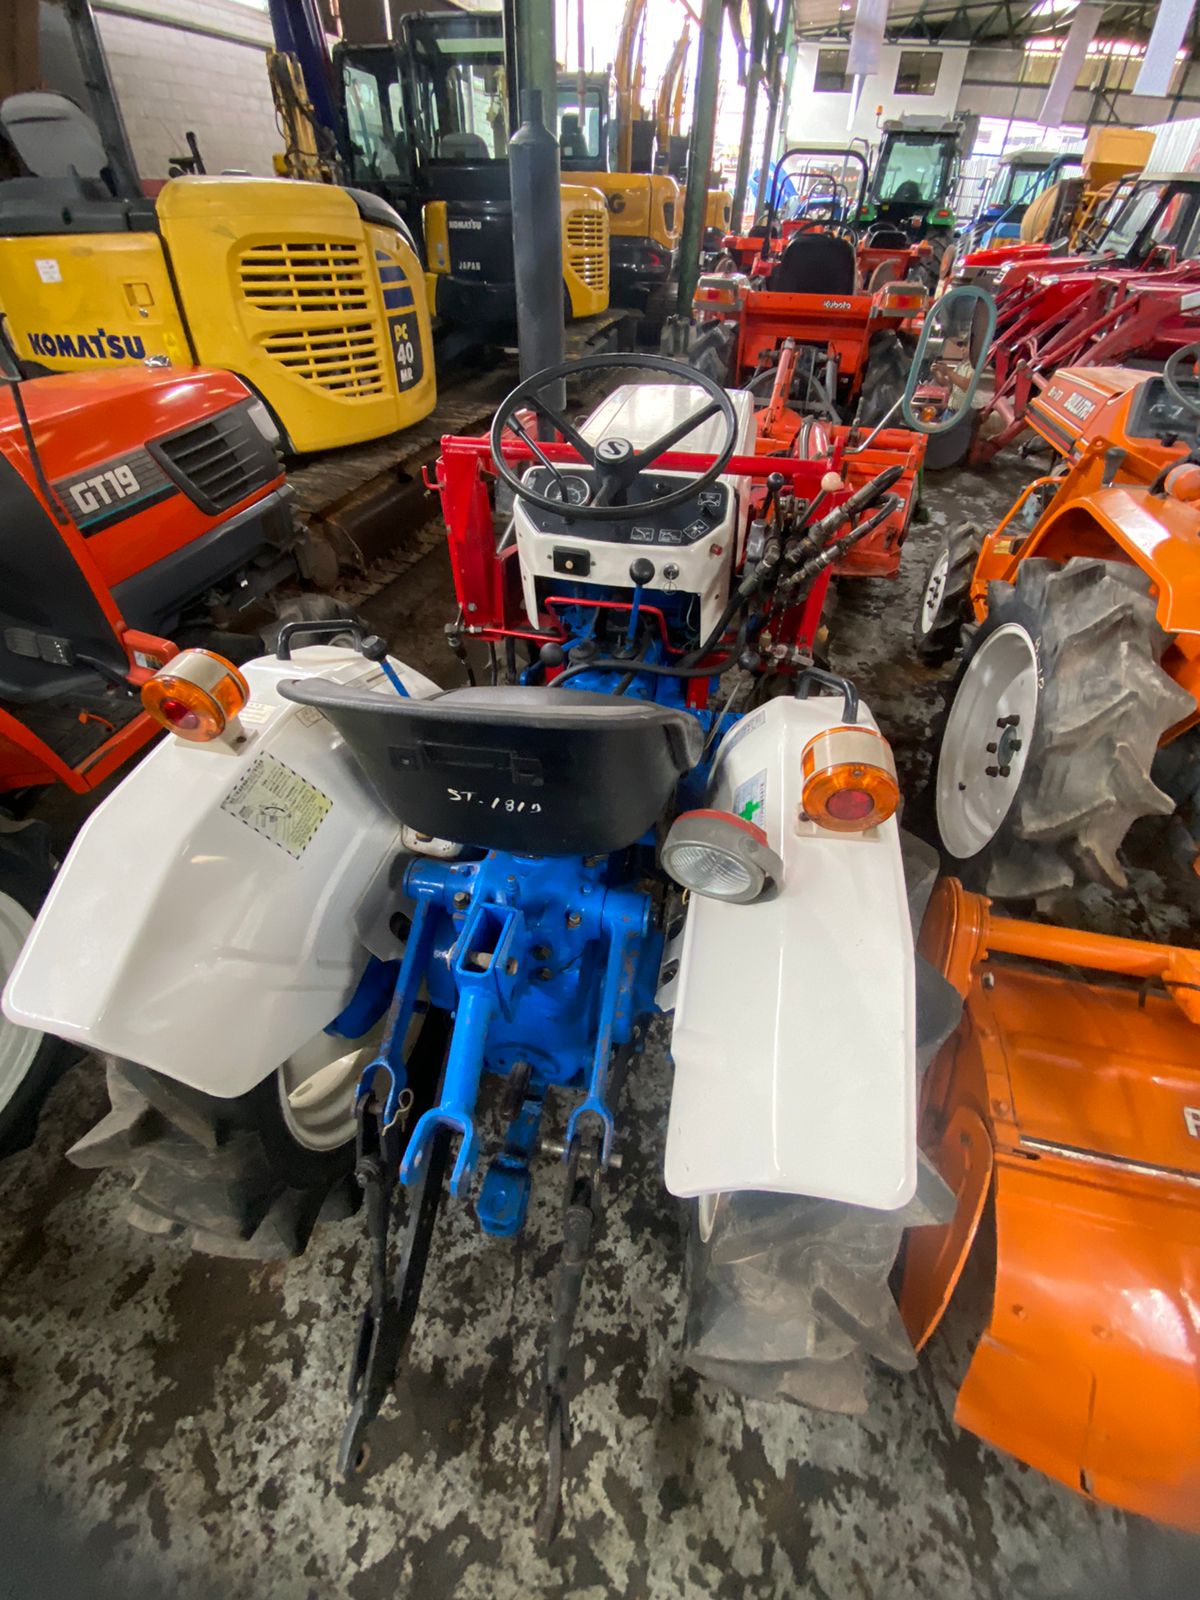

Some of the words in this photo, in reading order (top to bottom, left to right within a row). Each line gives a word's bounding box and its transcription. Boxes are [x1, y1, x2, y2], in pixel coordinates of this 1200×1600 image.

[448, 218, 482, 230] KOMATSU
[394, 323, 409, 342] PC
[27, 328, 146, 360] KOMATSU
[397, 342, 414, 365] 40
[400, 367, 414, 383] MR
[69, 464, 140, 514] GT19
